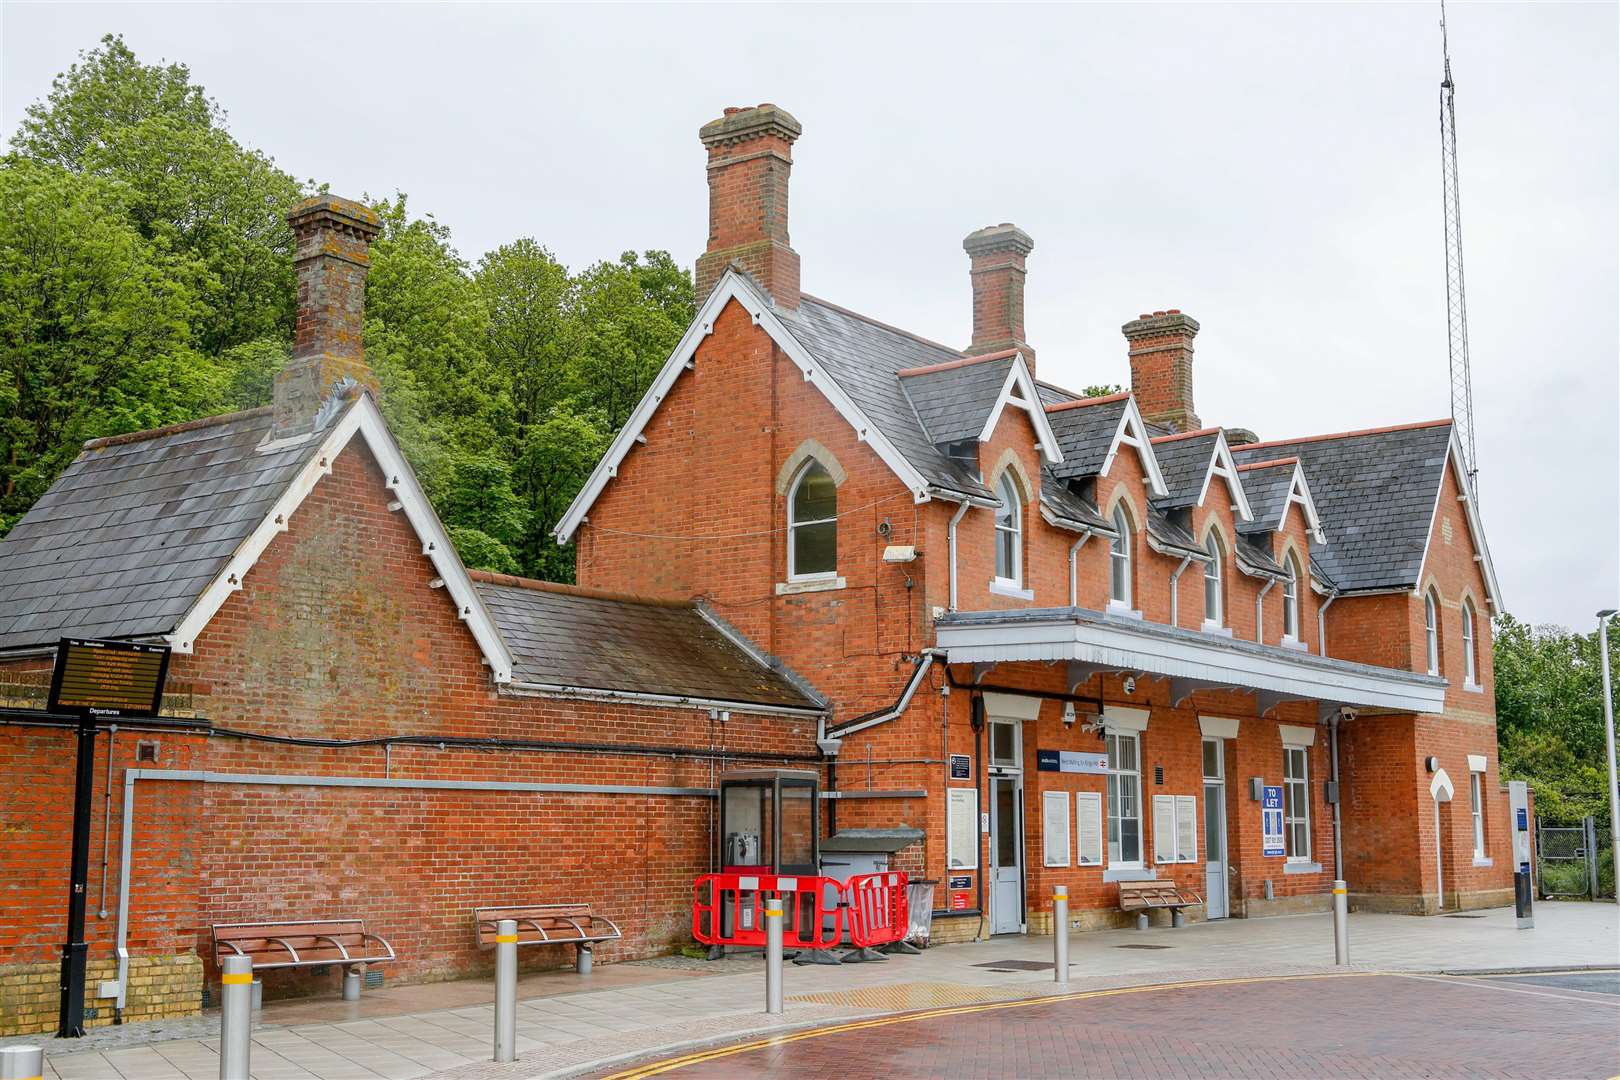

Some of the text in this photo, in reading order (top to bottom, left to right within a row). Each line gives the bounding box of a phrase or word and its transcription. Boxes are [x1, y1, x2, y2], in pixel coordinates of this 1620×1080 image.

[89, 707, 120, 716] Departures
[1268, 788, 1276, 797] TO
[1266, 798, 1278, 808] LET
